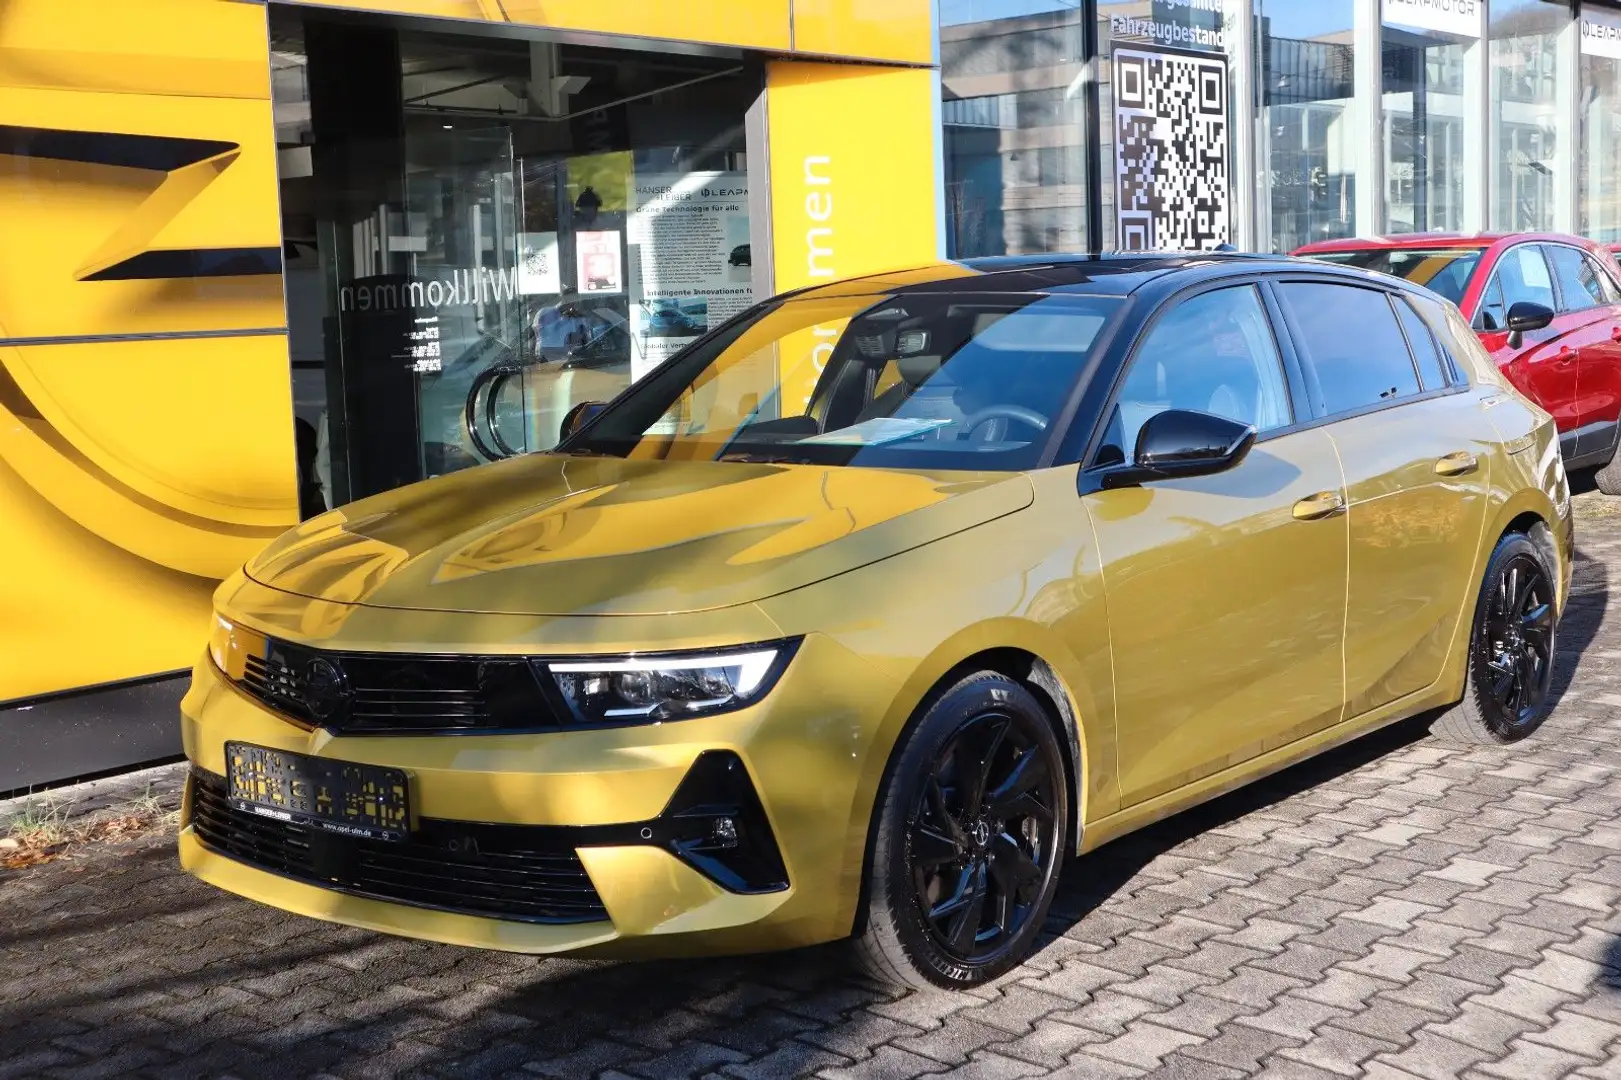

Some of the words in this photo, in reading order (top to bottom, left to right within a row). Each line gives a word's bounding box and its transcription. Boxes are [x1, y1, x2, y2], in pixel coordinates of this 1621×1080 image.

[1110, 13, 1224, 47] Fahrzeugbestand
[636, 186, 672, 194] HANSER
[662, 204, 709, 213] Technologie
[647, 289, 691, 297] Intelligente
[693, 288, 745, 296] Innovationen
[322, 822, 372, 837] www.opel-ulm.de
